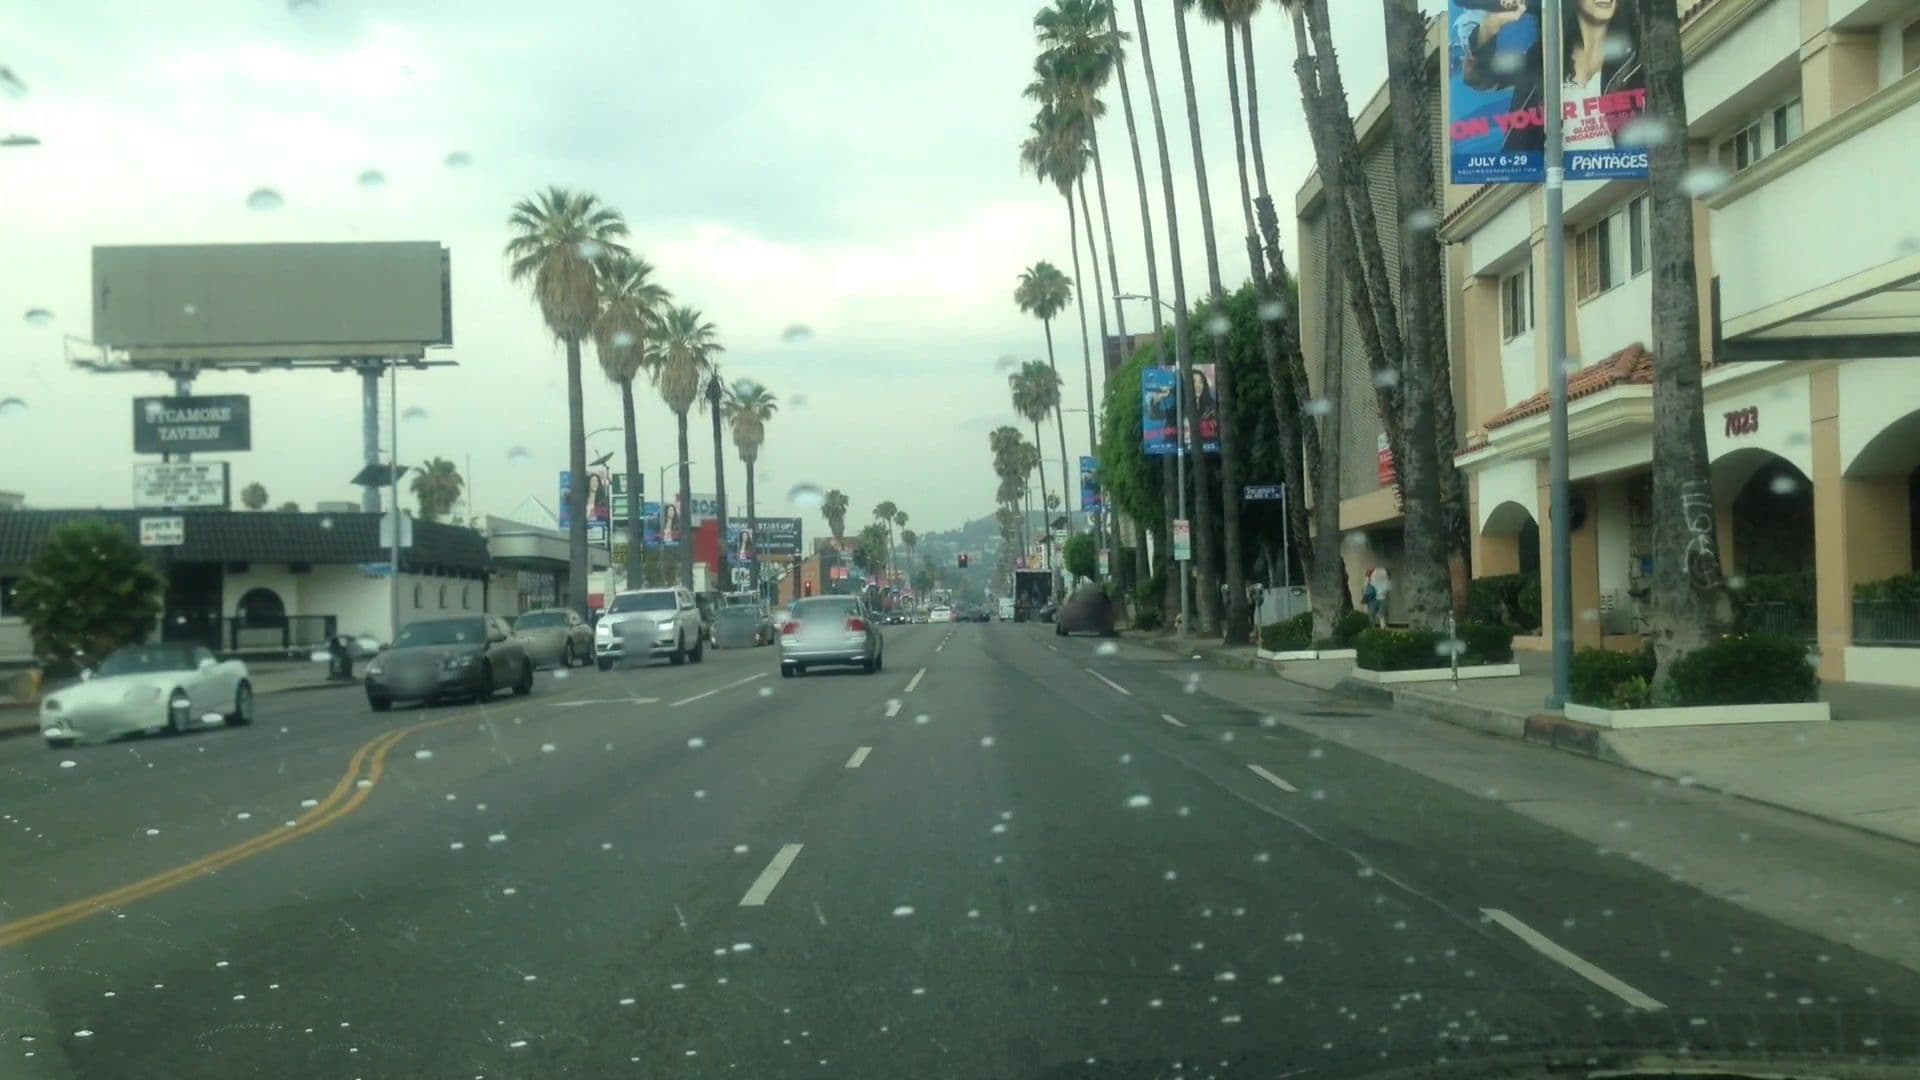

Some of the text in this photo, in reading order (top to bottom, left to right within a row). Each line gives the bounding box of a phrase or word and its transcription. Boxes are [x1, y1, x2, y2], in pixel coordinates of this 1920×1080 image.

[1449, 117, 1489, 140] ON
[1582, 87, 1646, 117] FEET
[1468, 156, 1496, 167] JULY
[1571, 153, 1649, 171] PANTAGES
[1723, 406, 1759, 438] 7023
[158, 426, 220, 440] TAVERN
